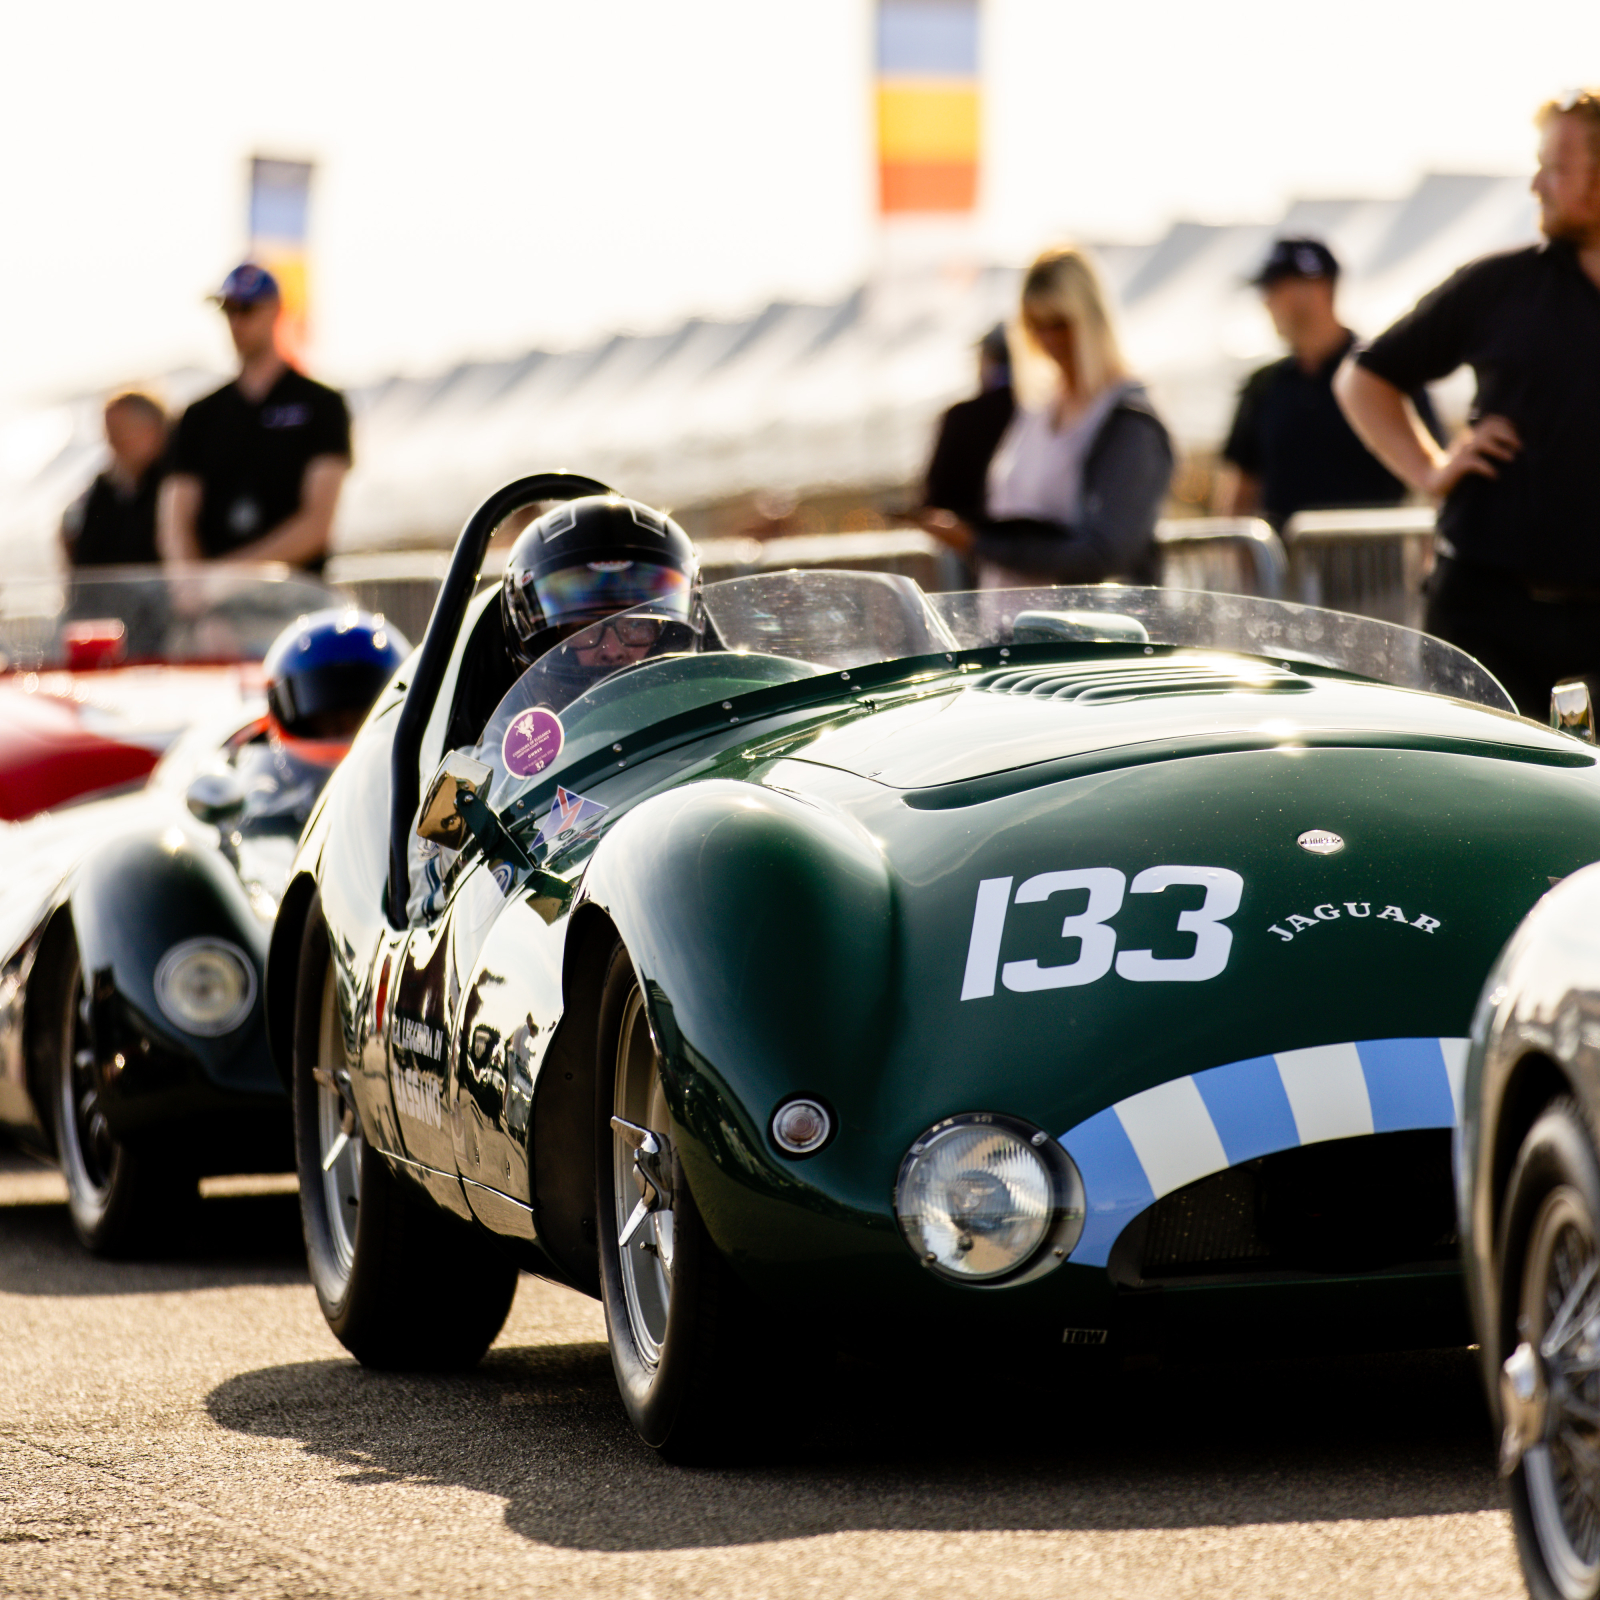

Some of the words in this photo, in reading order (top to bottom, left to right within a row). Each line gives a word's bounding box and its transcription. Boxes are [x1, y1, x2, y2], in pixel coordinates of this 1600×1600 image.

[960, 865, 1244, 1001] 133
[1267, 902, 1441, 942] JAGUAR
[1066, 1330, 1104, 1343] TOW
